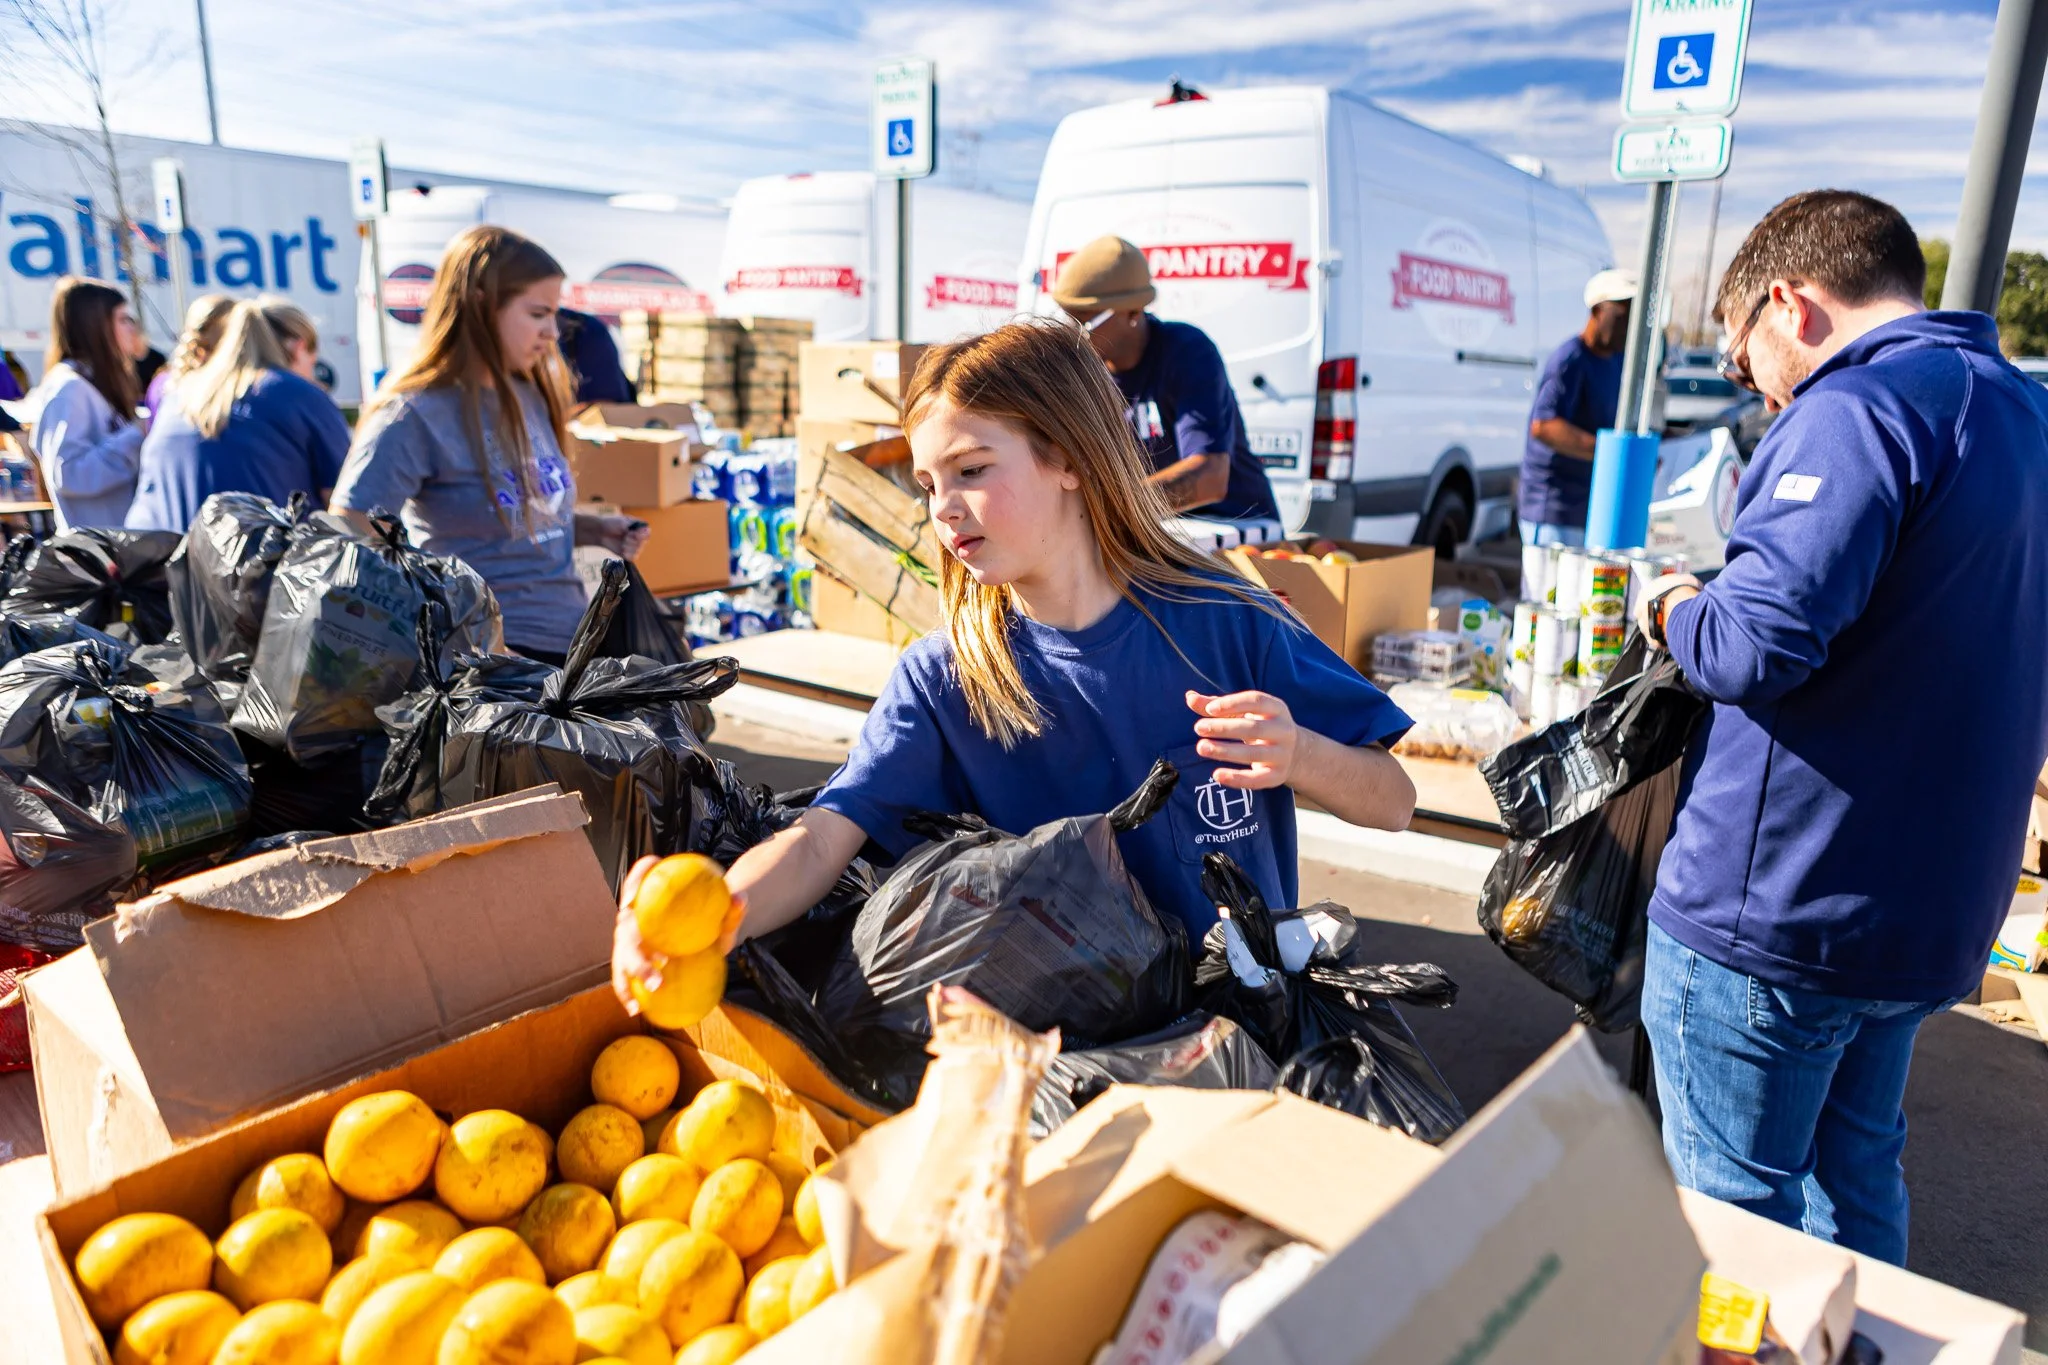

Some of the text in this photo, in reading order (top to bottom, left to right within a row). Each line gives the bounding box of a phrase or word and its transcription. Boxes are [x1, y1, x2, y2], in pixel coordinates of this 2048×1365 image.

[0, 190, 338, 292] almart
[1150, 246, 1269, 277] PANTRY
[946, 279, 993, 303] FOOD
[1409, 260, 1502, 304] FOOD PANTRY
[1194, 821, 1259, 844] @TREYHELPS
